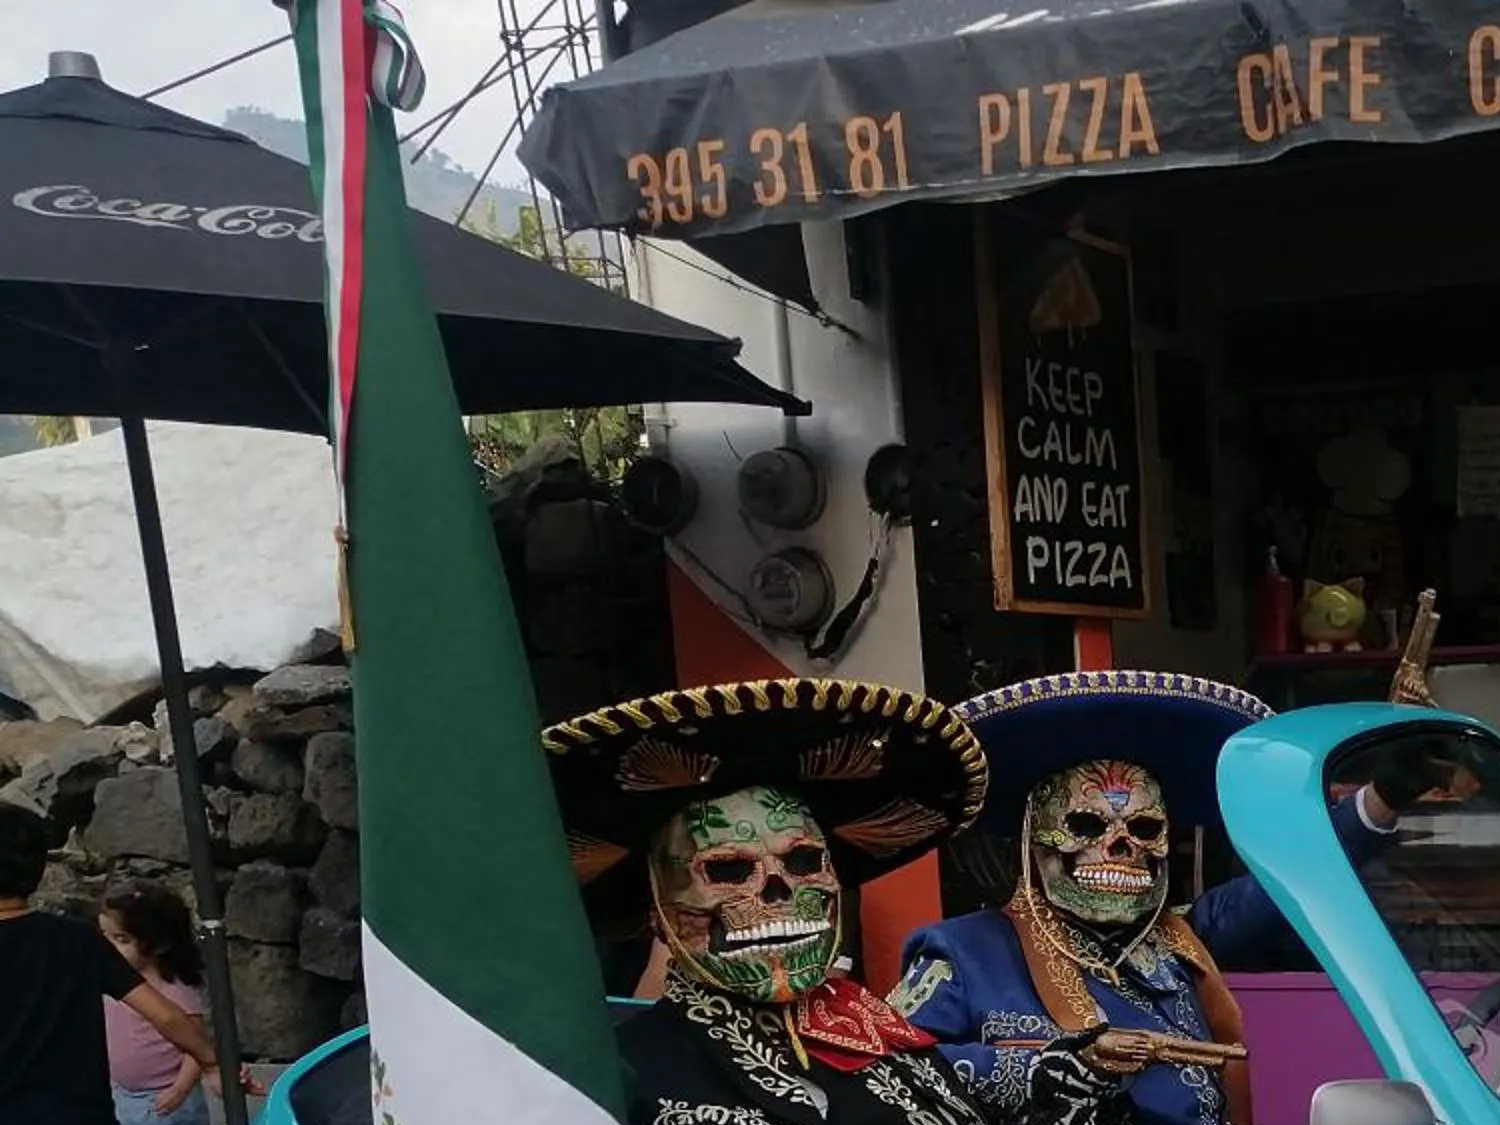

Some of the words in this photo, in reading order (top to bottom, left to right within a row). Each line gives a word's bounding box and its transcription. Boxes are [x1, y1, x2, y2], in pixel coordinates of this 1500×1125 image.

[627, 139, 728, 228] 395
[751, 121, 819, 207] 31
[845, 111, 909, 199] 81
[979, 72, 1160, 175] PIZZA
[1237, 36, 1382, 142] CAFE
[13, 185, 324, 243] Coca-Col
[1026, 357, 1104, 416] KEEP
[1018, 416, 1117, 470] CALM
[1014, 474, 1068, 524] AND
[1081, 481, 1131, 528] EAT
[1026, 536, 1132, 588] PIZZA
